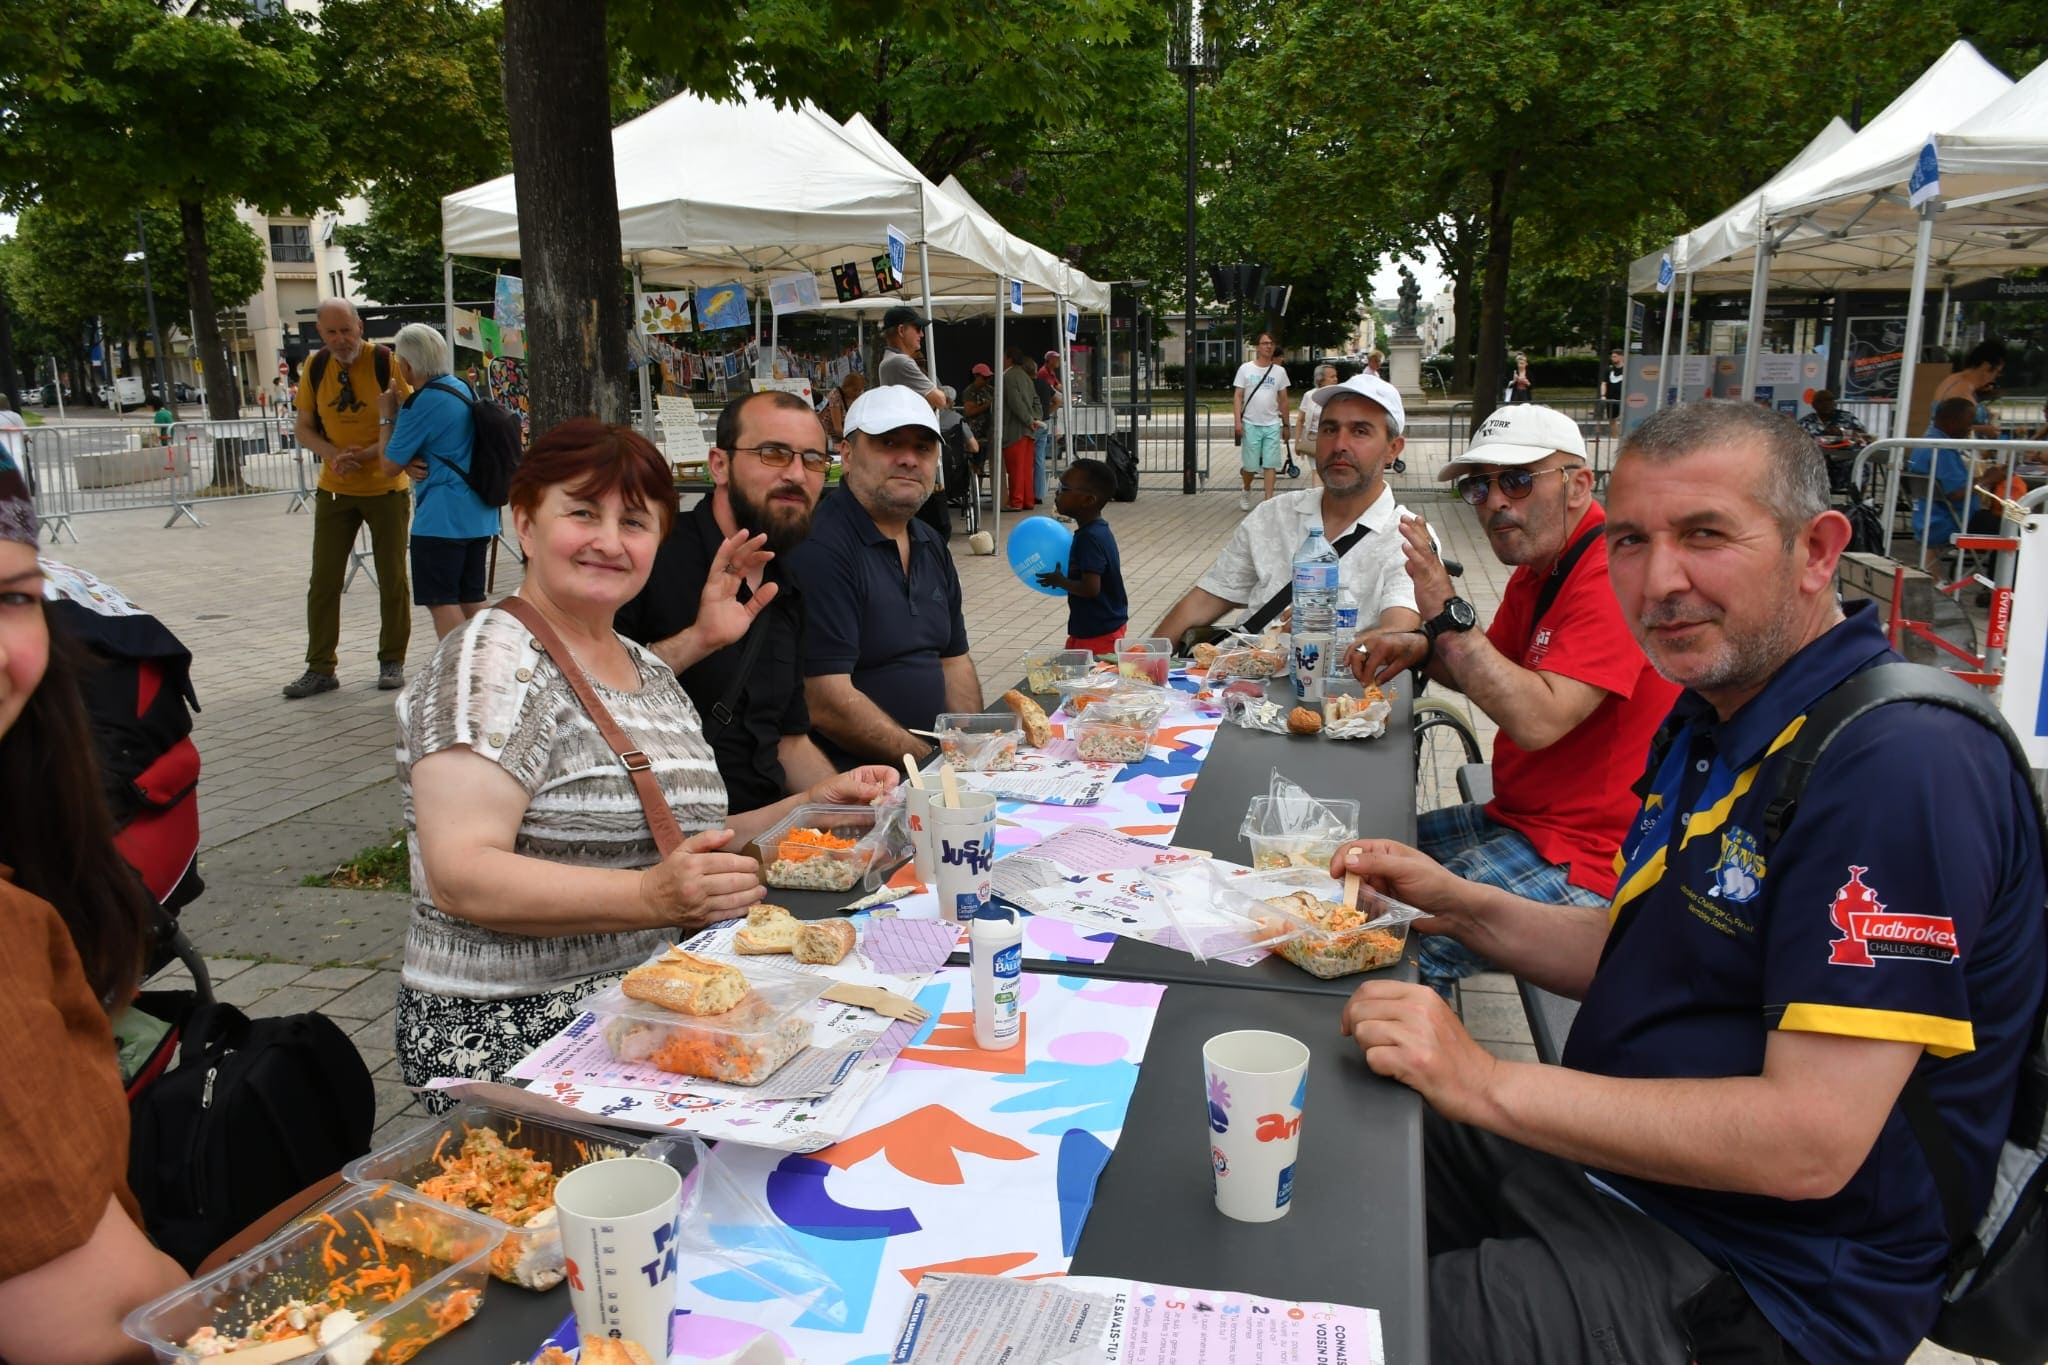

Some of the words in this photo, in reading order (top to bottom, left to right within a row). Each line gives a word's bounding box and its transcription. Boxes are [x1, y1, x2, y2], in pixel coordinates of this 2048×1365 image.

[1490, 419, 1511, 429] YORK
[1996, 591, 2010, 632] ALTRAD
[1862, 918, 1957, 946] Ladbrokes
[1869, 941, 1926, 956] CHALLENGE
[1928, 948, 1951, 960] CUP
[1116, 1293, 1126, 1304] LE
[1166, 1300, 1185, 1309] 5
[914, 1299, 925, 1314] POUR
[1192, 1302, 1215, 1312] 4
[1222, 1305, 1240, 1314] 3
[1252, 1306, 1270, 1314] 2
[1075, 1303, 1090, 1329] CHIFFRES
[903, 1323, 917, 1343] SAVOIR
[1107, 1306, 1124, 1353] SAVAIS-TU
[1317, 1324, 1327, 1355] VOISIN
[897, 1344, 909, 1359] PLUS
